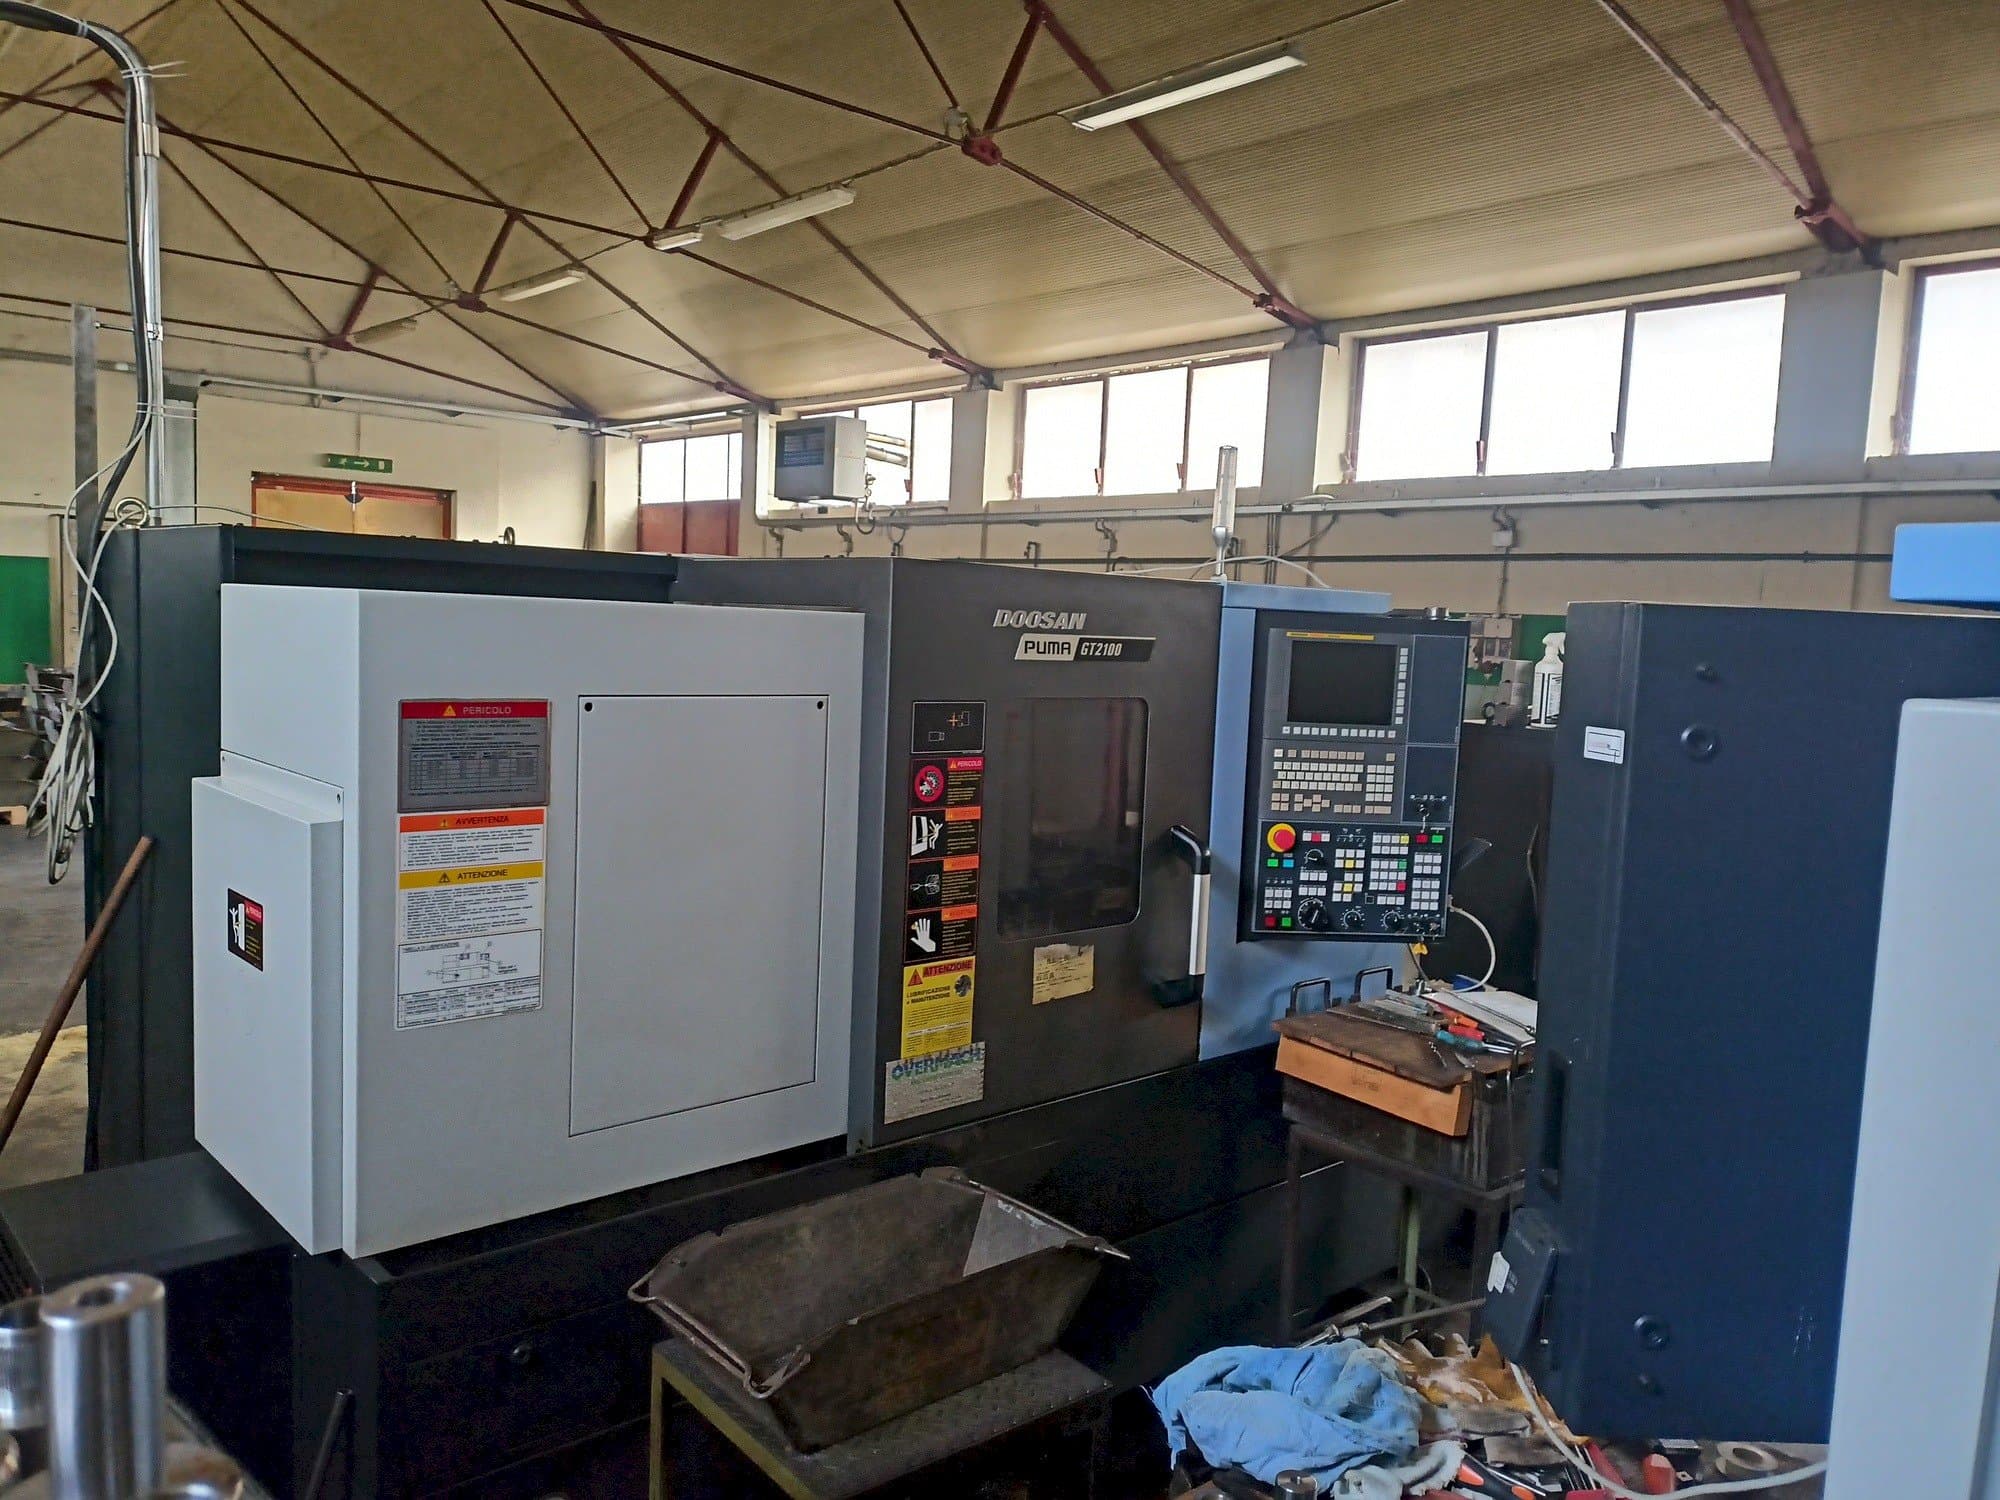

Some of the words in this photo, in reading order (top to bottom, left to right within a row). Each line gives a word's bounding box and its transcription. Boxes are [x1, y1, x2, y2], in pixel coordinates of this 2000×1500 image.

[993, 609, 1087, 630] DOOSAN
[1024, 640, 1071, 655] PUMA
[1080, 642, 1123, 657] GT2100
[463, 706, 512, 715] PERICOLO
[455, 816, 509, 826] AVVERTENZA
[457, 869, 509, 880] ATTENZIONE
[923, 959, 974, 977] ATTENZIONE
